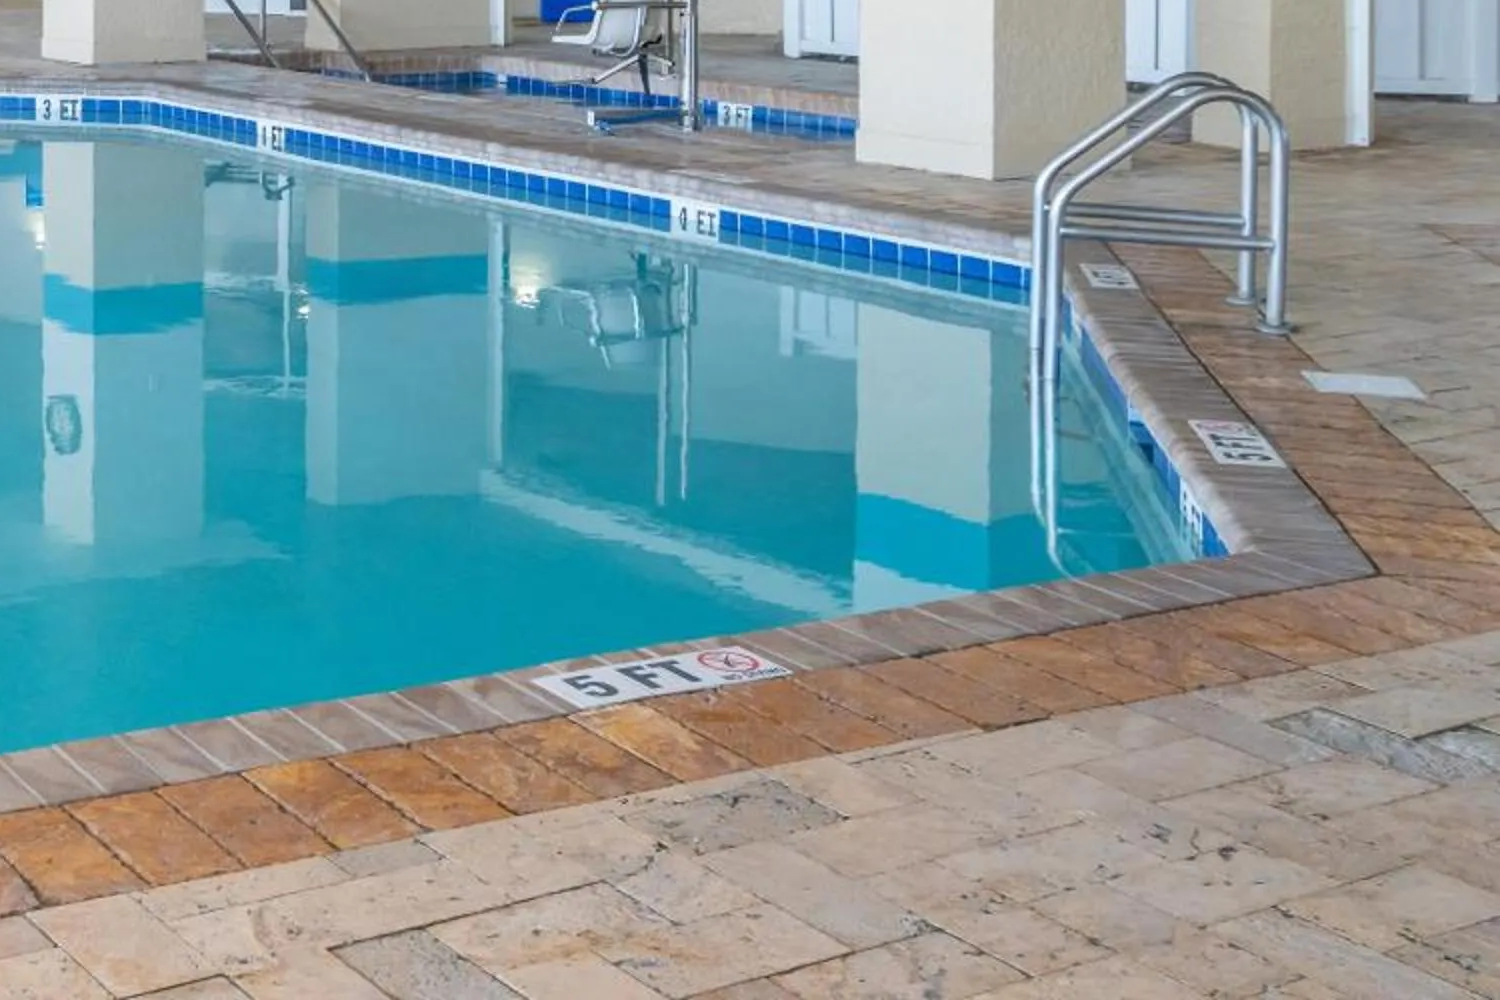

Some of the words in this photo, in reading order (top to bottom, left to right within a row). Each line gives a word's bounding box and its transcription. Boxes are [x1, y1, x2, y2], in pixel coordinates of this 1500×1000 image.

[43, 99, 52, 121] 3
[1209, 434, 1265, 450] FT
[1222, 452, 1273, 461] 5
[563, 675, 619, 698] 5
[616, 660, 702, 689] FT
